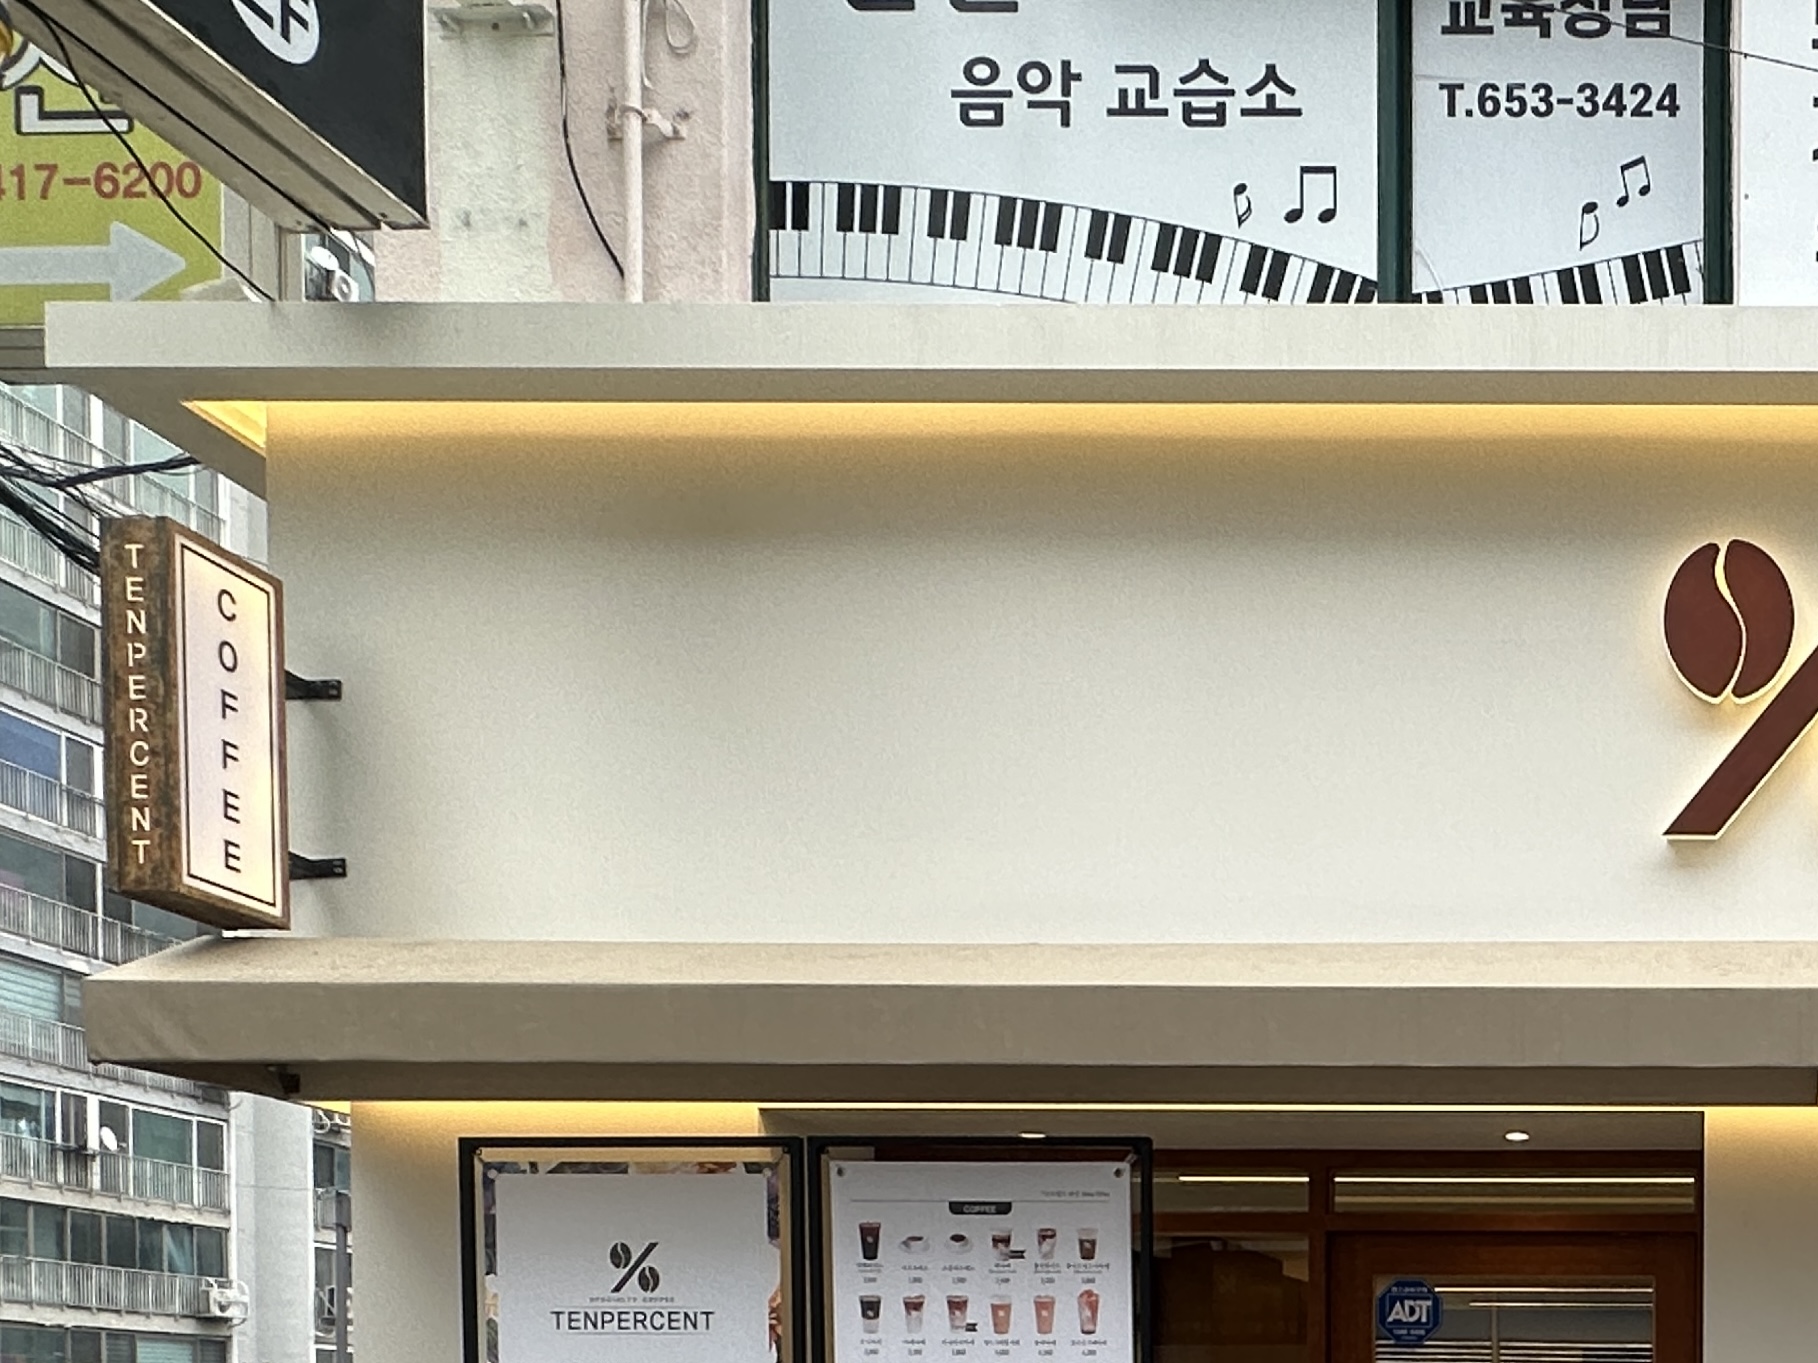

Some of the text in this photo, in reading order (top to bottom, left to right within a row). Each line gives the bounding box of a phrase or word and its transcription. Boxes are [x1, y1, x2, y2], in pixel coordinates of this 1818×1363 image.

[950, 55, 1303, 128] 음악 교습소
[1438, 82, 1681, 118] T.653-3424
[124, 543, 152, 865] TENPERCENT
[216, 587, 242, 874] COFFEE
[550, 1311, 715, 1331] TENPERCENT
[1386, 1299, 1433, 1323] ADT
